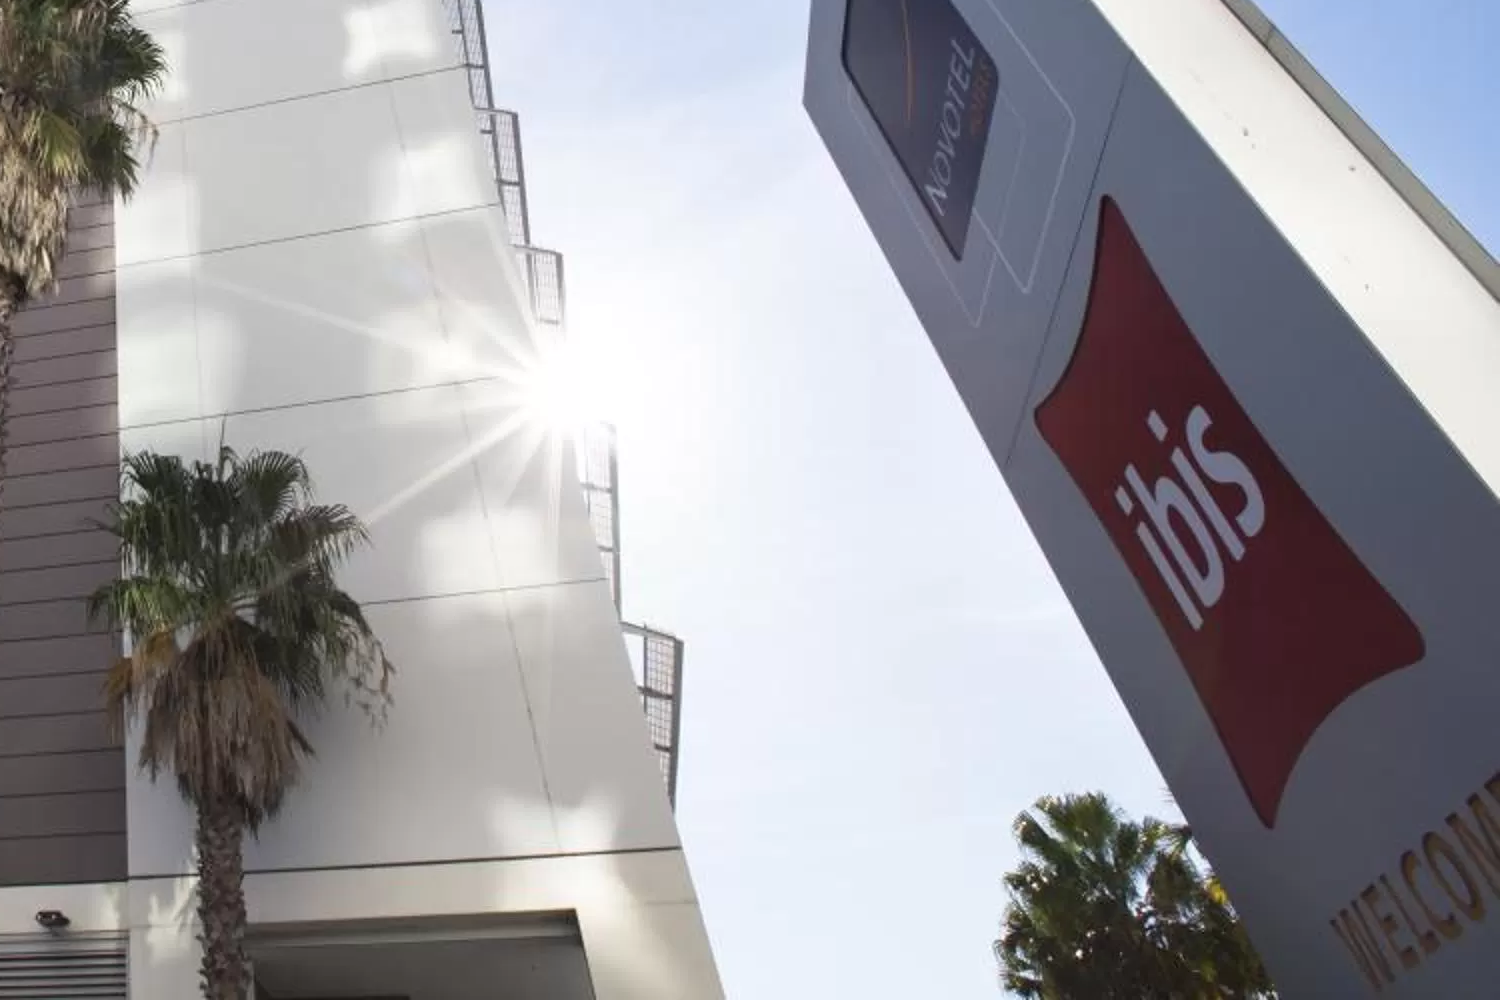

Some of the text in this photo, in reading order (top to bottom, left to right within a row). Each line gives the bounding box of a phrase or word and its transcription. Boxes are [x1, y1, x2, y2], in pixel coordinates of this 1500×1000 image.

[924, 37, 975, 217] NOVOTEL
[1114, 404, 1266, 630] ibis
[1328, 771, 1500, 992] WELCOM
